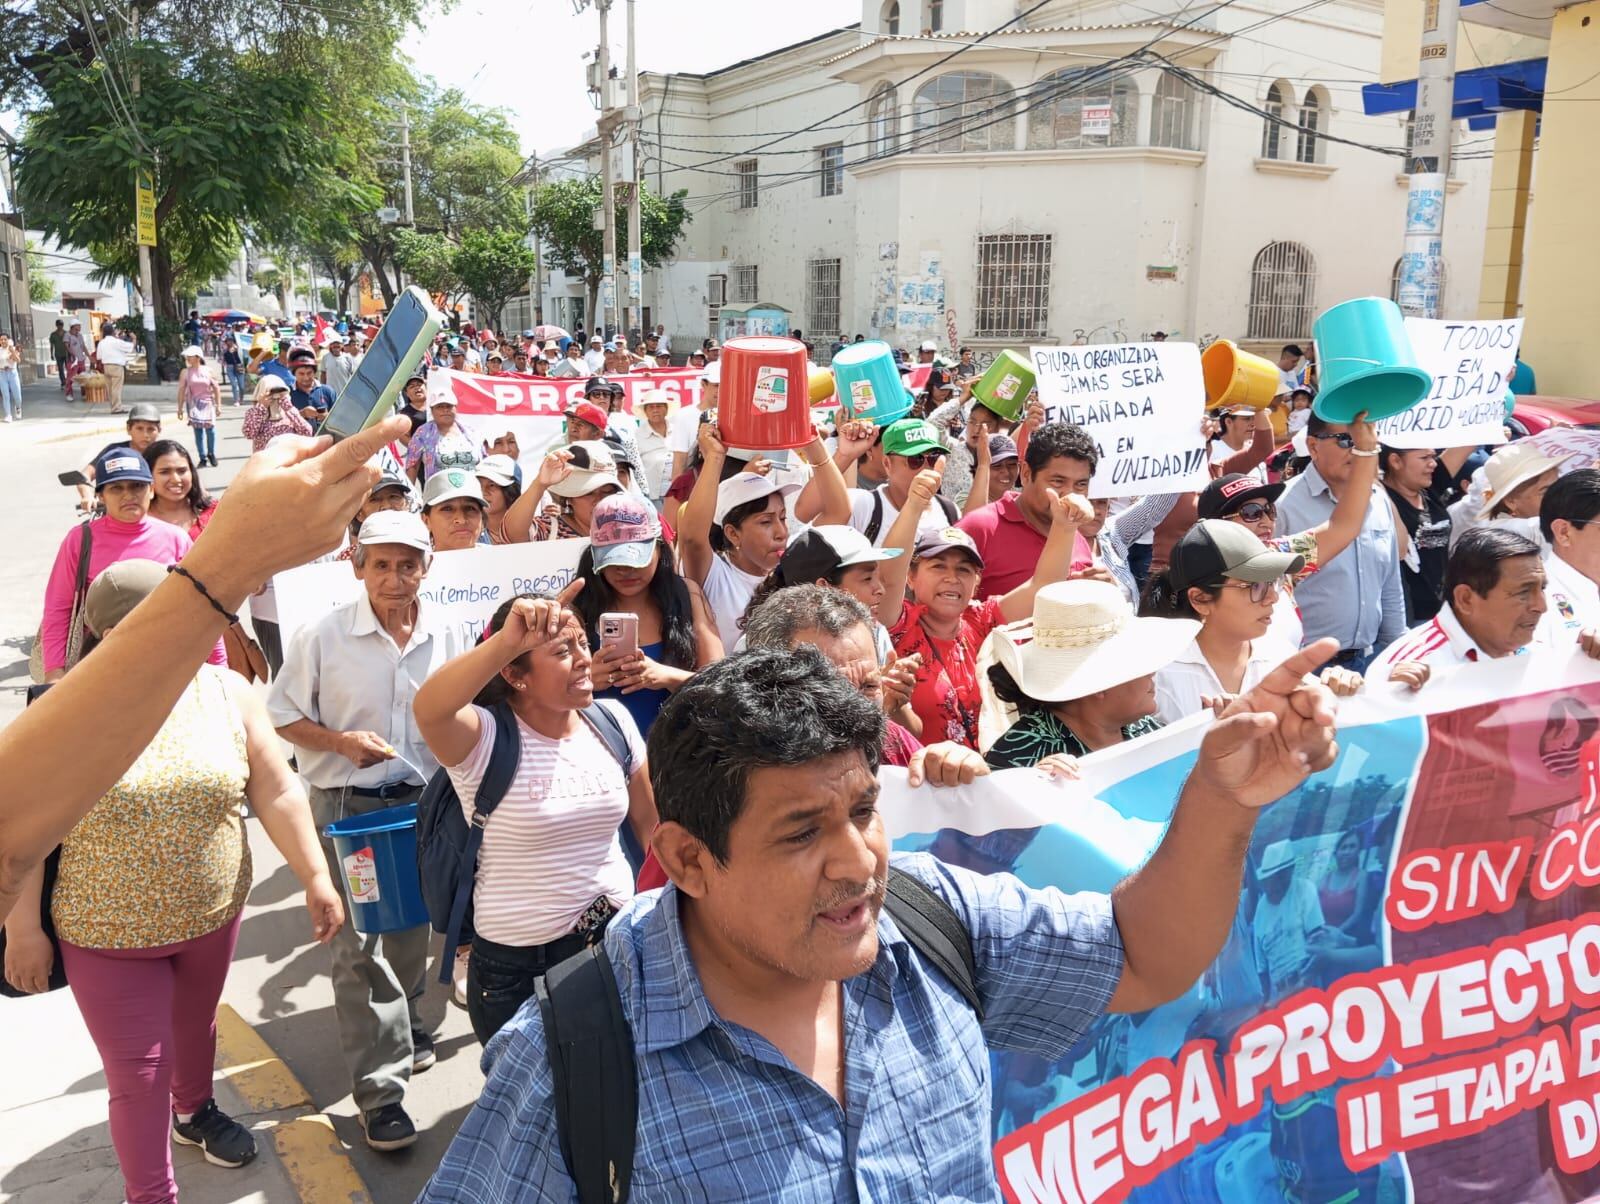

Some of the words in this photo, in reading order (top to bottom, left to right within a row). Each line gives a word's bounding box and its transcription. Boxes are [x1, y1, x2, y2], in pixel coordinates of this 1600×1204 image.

[1443, 324, 1516, 351] TODOS
[1035, 350, 1081, 375] PIURA
[1083, 346, 1159, 370] ORGANIZADA
[1457, 358, 1483, 374] EN
[1116, 437, 1135, 454] EN
[1396, 846, 1521, 921] SIN
[1347, 1091, 1383, 1157] II
[1398, 1039, 1566, 1139] ETAPA
[1002, 1049, 1222, 1204] MEGA
